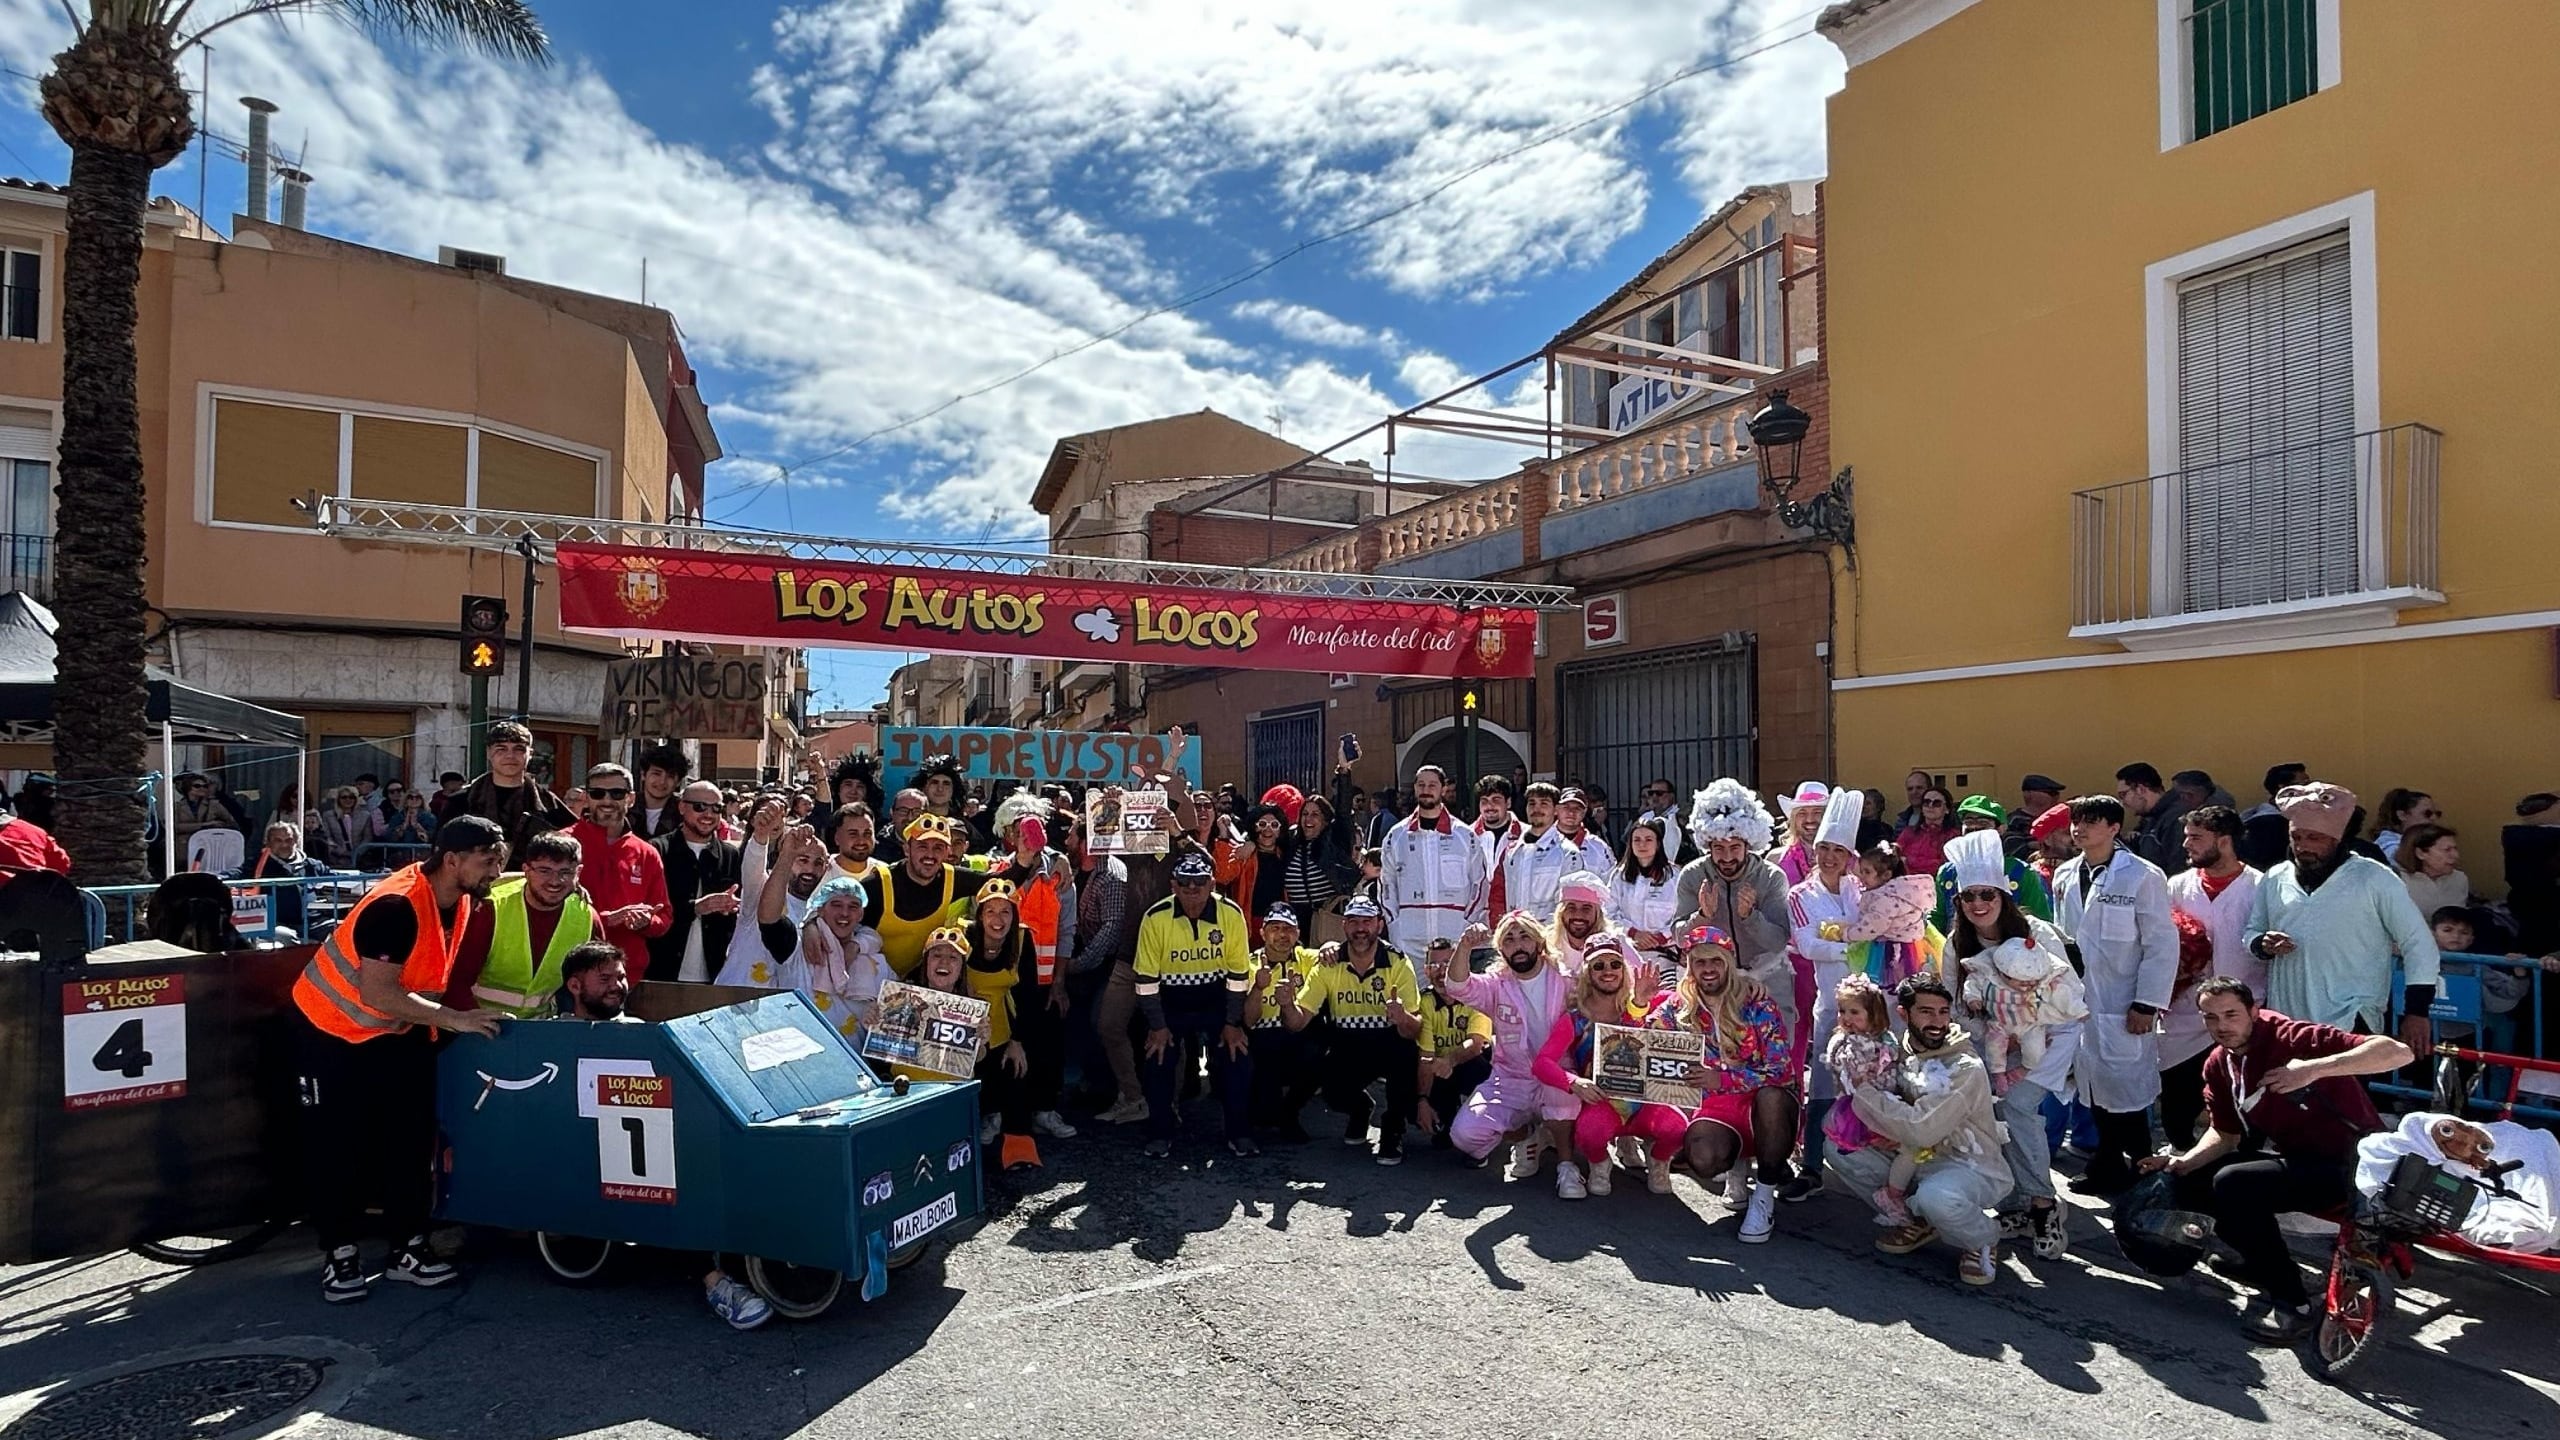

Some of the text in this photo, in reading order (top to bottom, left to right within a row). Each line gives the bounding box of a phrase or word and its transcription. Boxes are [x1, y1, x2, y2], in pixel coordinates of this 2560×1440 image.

[1587, 598, 1617, 641] S
[1287, 624, 1456, 655] Monforte del Cid
[613, 660, 764, 701] VIKINGOS
[615, 699, 759, 735] DE MALTA
[890, 732, 1163, 780] IMPREVISTO
[236, 899, 266, 910] LIDA
[2098, 894, 2136, 905] DOCTOR
[935, 992, 984, 1018] PREMIO
[93, 1018, 153, 1078] 4
[1648, 1031, 1700, 1050] PREMIO
[621, 1117, 646, 1177] 1
[895, 1197, 954, 1244] MARLBORO
